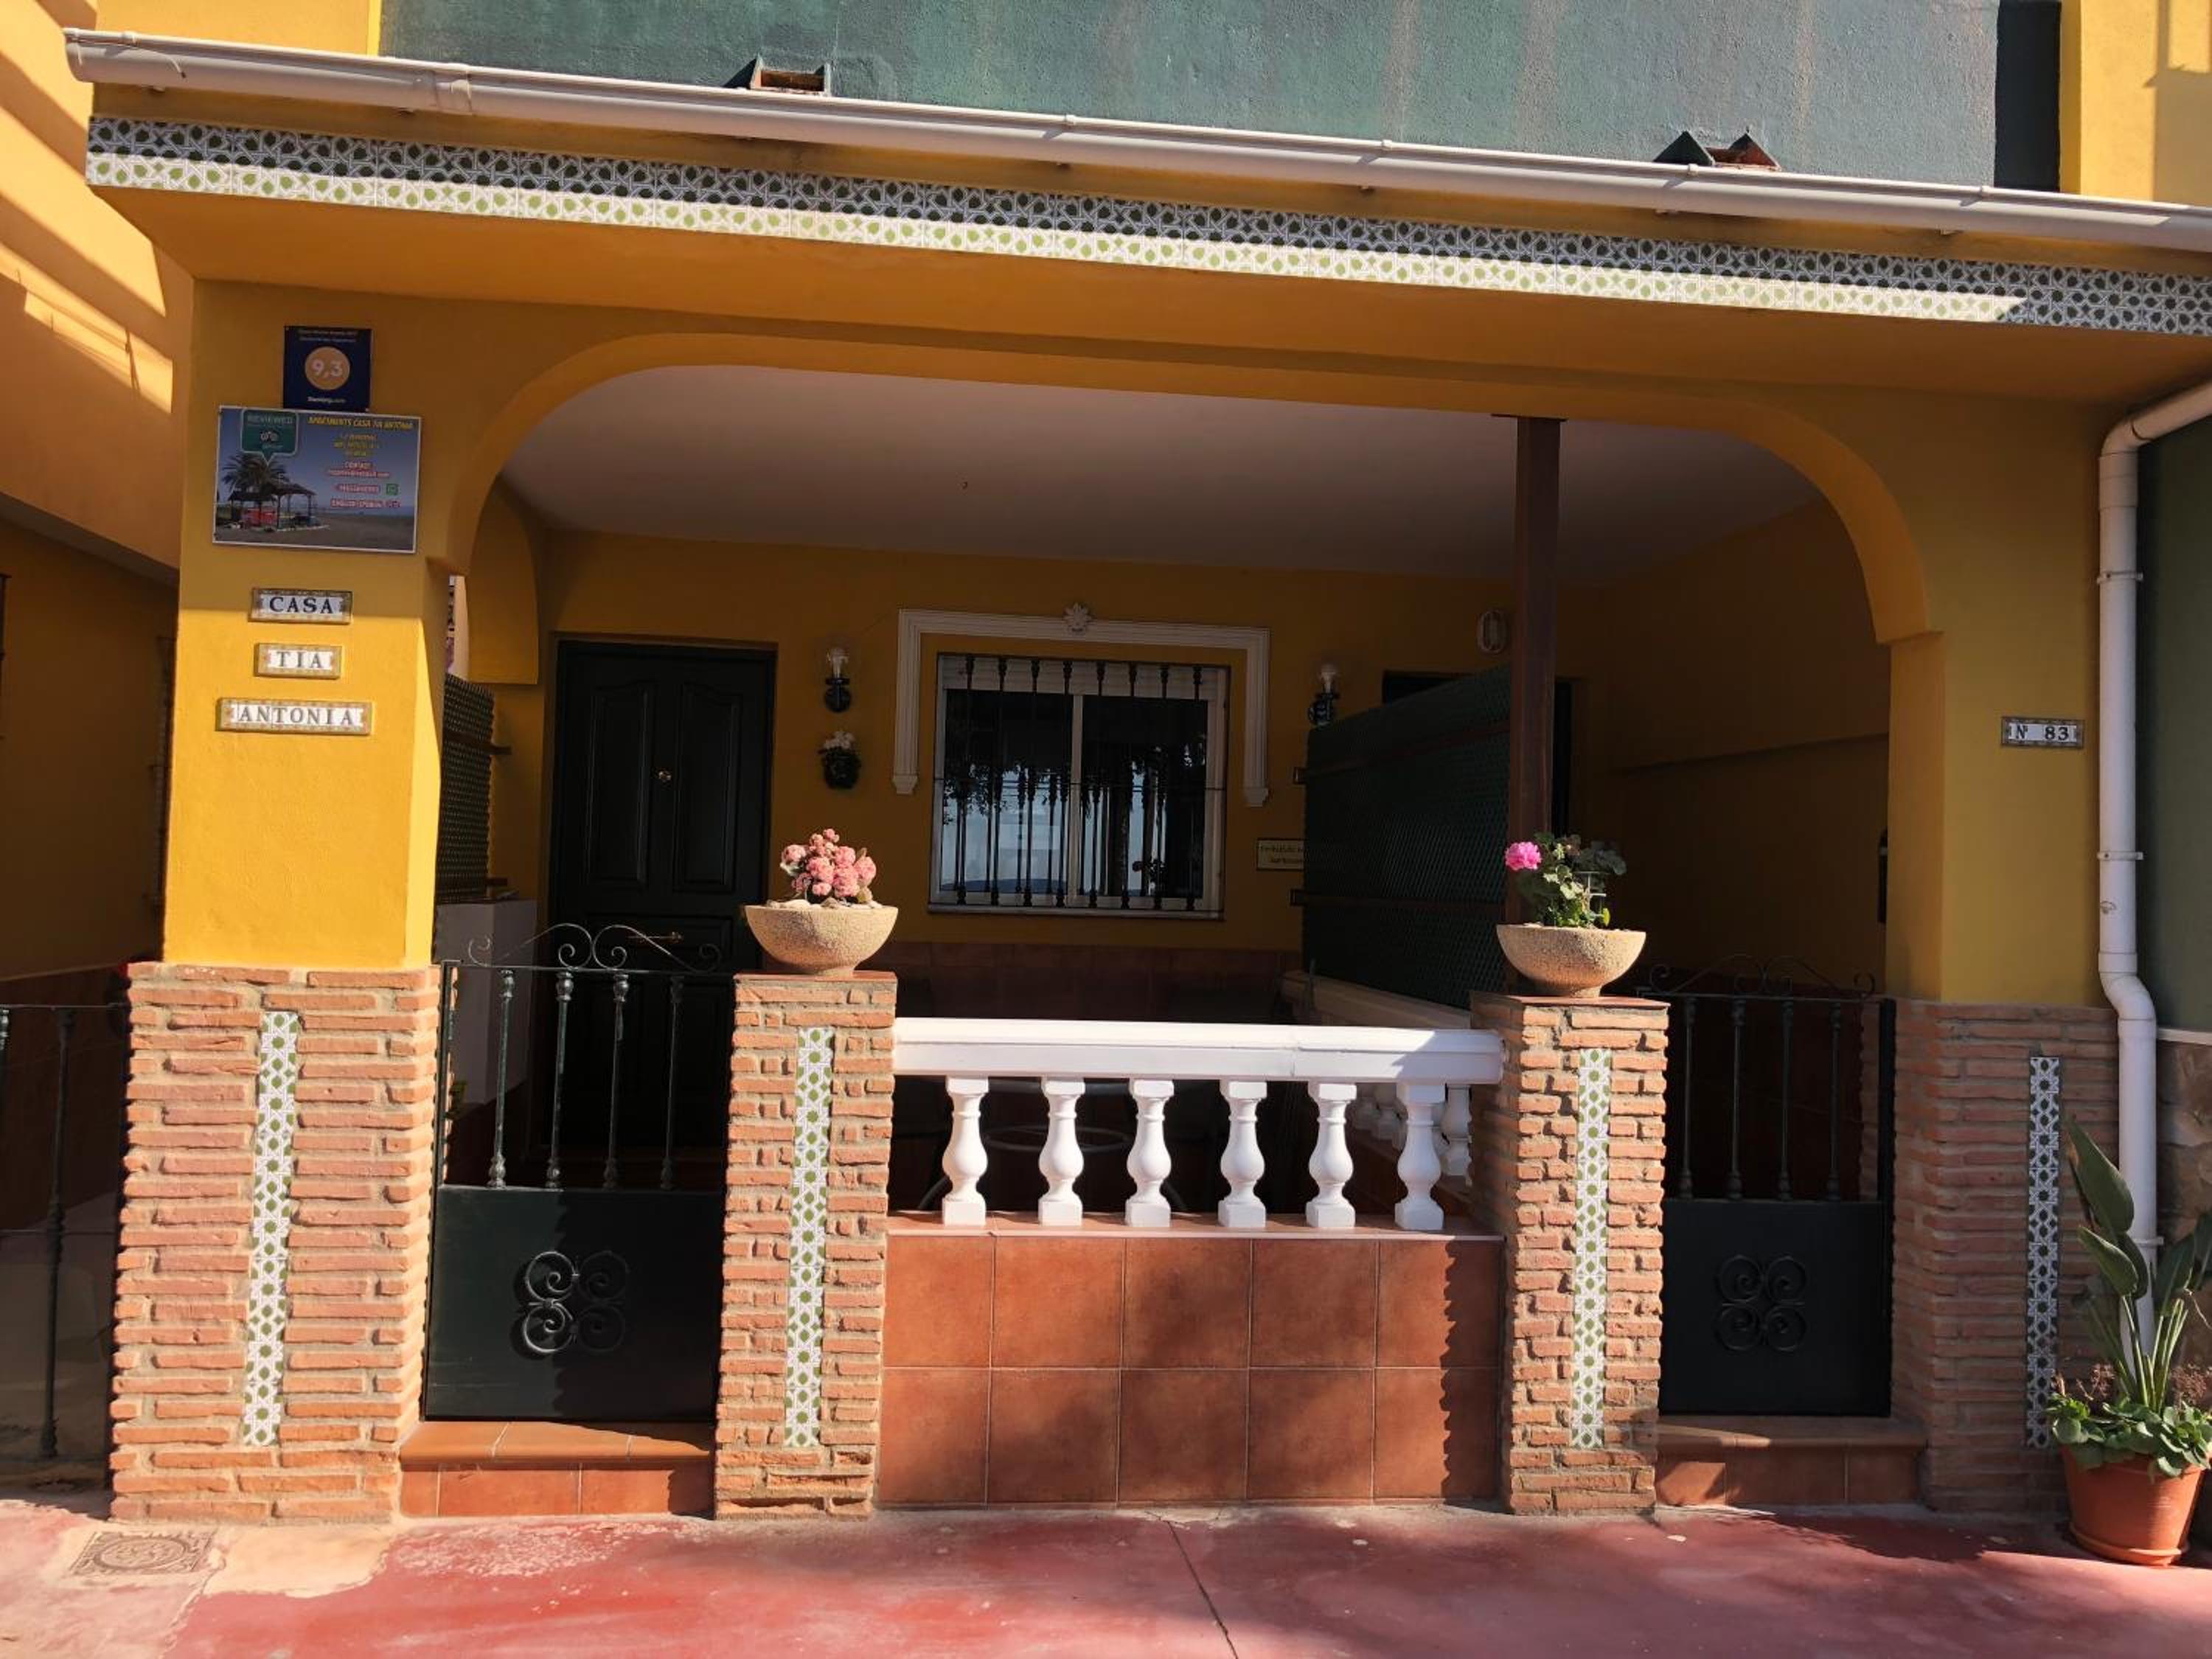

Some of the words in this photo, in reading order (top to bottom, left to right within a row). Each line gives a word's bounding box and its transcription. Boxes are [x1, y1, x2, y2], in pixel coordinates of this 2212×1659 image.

[312, 358, 344, 378] 9,3
[270, 597, 333, 613] CASA
[276, 651, 323, 668] TIA
[240, 706, 355, 725] ANTONIA
[2045, 726, 2070, 741] 83
